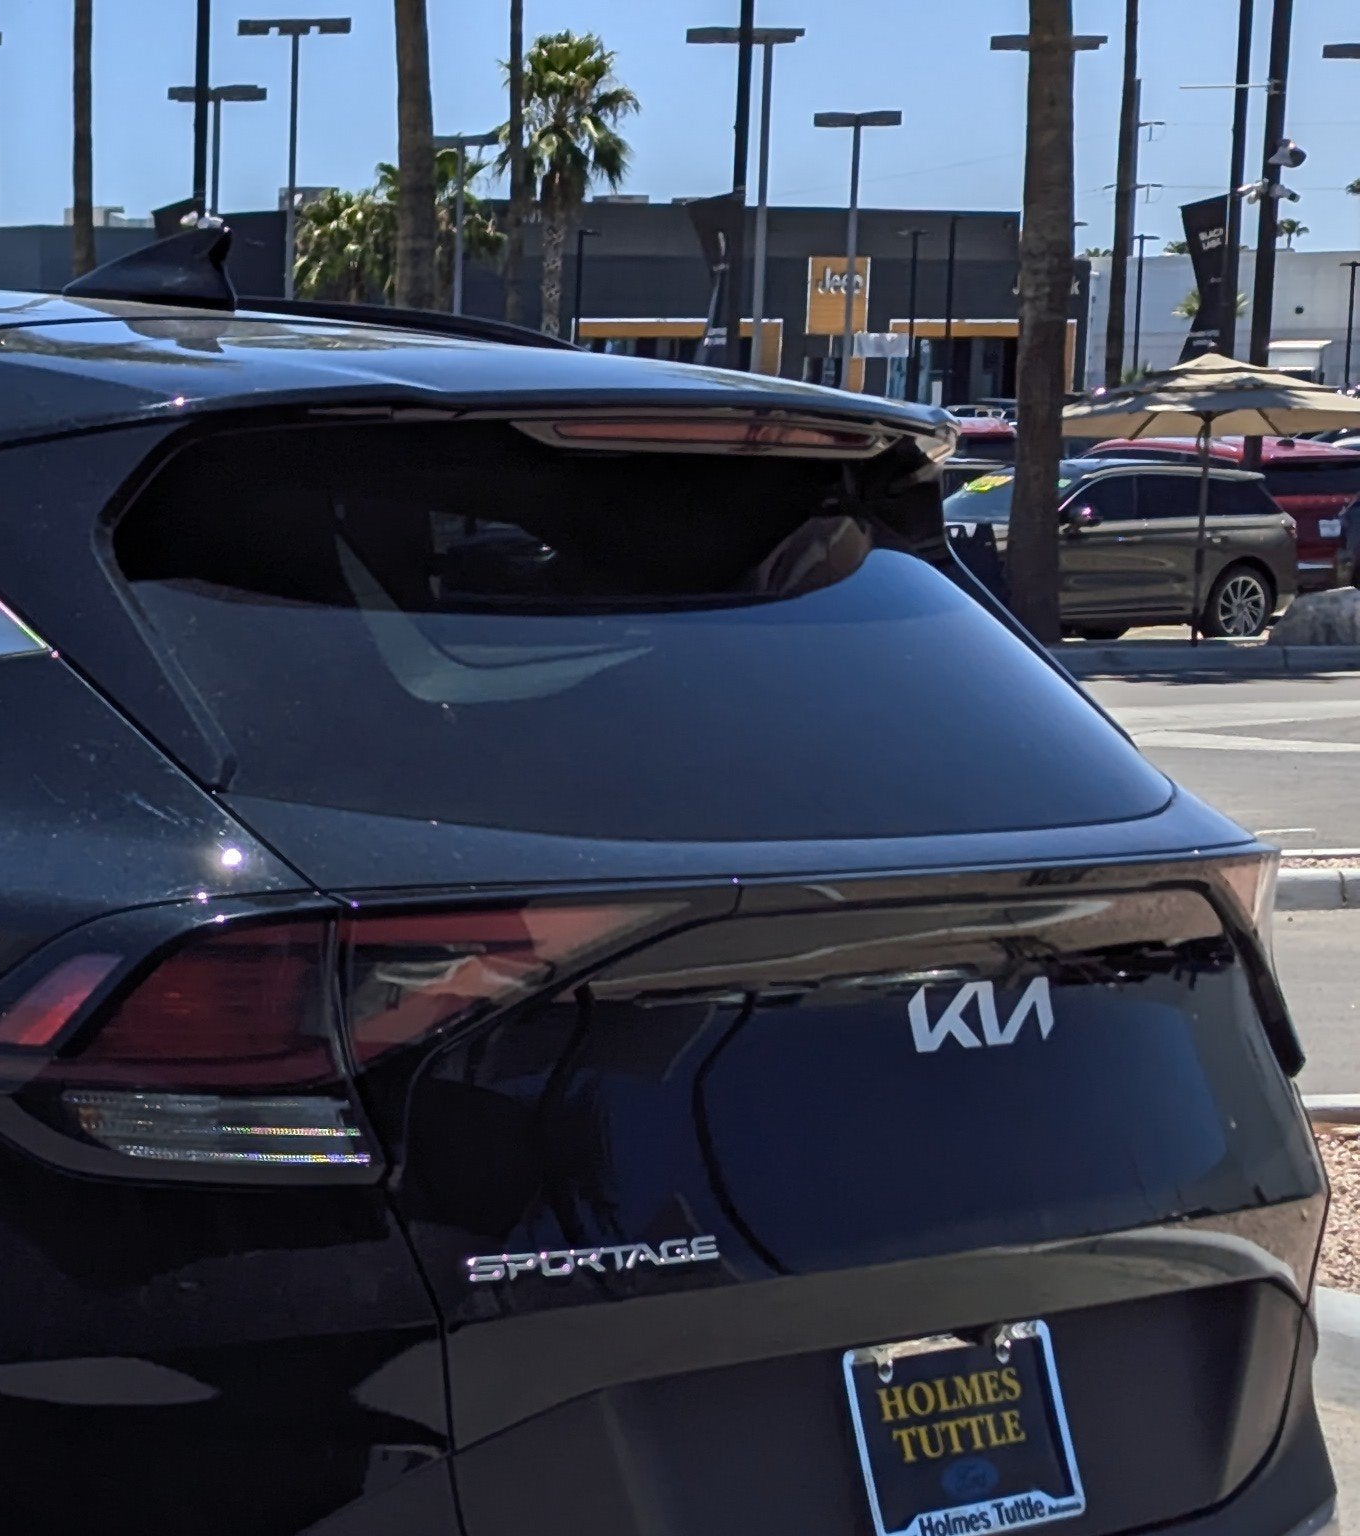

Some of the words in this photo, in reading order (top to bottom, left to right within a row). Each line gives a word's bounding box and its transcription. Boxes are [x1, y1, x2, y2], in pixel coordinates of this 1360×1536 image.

[907, 975, 1055, 1054] KIA
[464, 1234, 721, 1282] SPORTAGE
[877, 1367, 1022, 1422] HOLMES
[892, 1410, 1027, 1463] TUTTLE
[991, 1497, 1047, 1527] Tuttle
